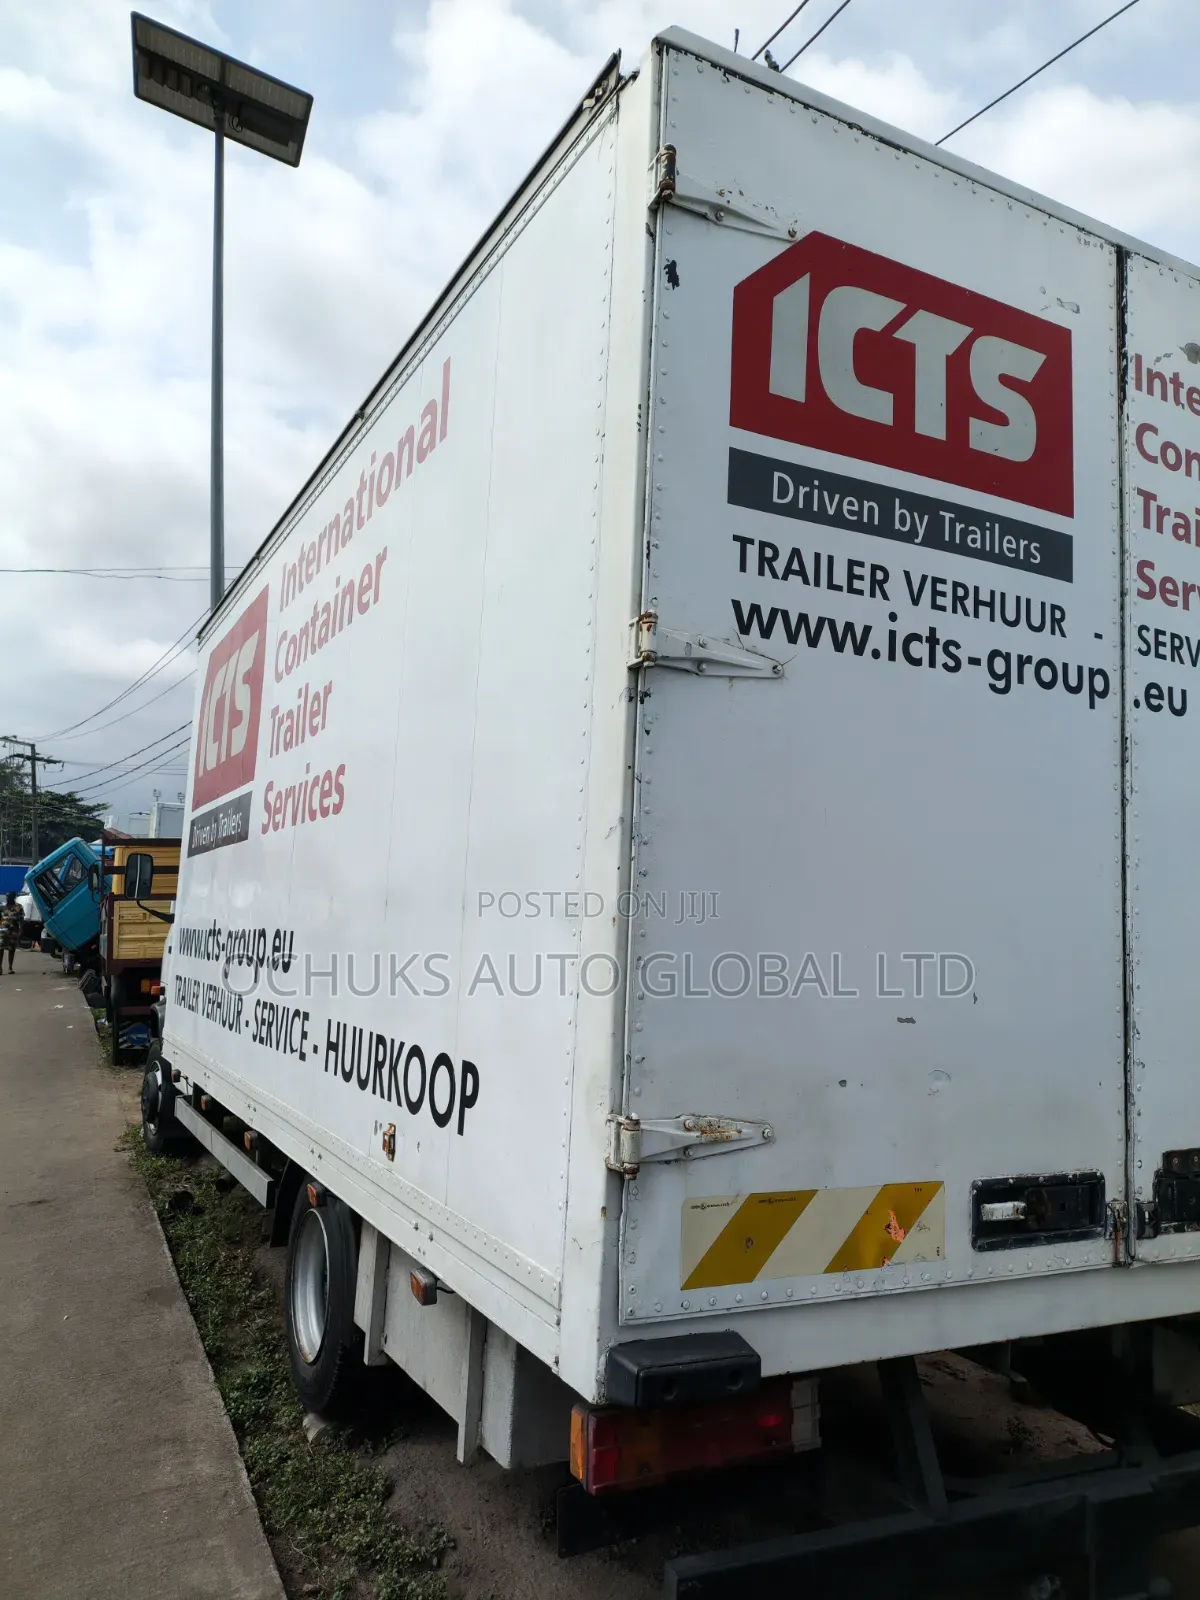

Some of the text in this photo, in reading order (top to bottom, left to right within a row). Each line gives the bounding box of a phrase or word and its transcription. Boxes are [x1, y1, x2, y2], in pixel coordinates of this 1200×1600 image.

[769, 272, 1048, 463] ICTS
[279, 357, 452, 613] International
[772, 471, 1042, 565] Driven by Trailers
[274, 546, 388, 684] Container
[732, 534, 891, 601] TRAILER
[903, 570, 1067, 638] VERHUUR
[1136, 559, 1200, 612] Ser
[198, 628, 262, 779] ICTS
[269, 680, 333, 758] Trailer
[261, 763, 346, 836] Services
[174, 974, 201, 1015] TRAILER
[201, 982, 243, 1035] VERHUUR
[252, 998, 310, 1062] SERVICE
[324, 1018, 480, 1137] HUURKOOP
